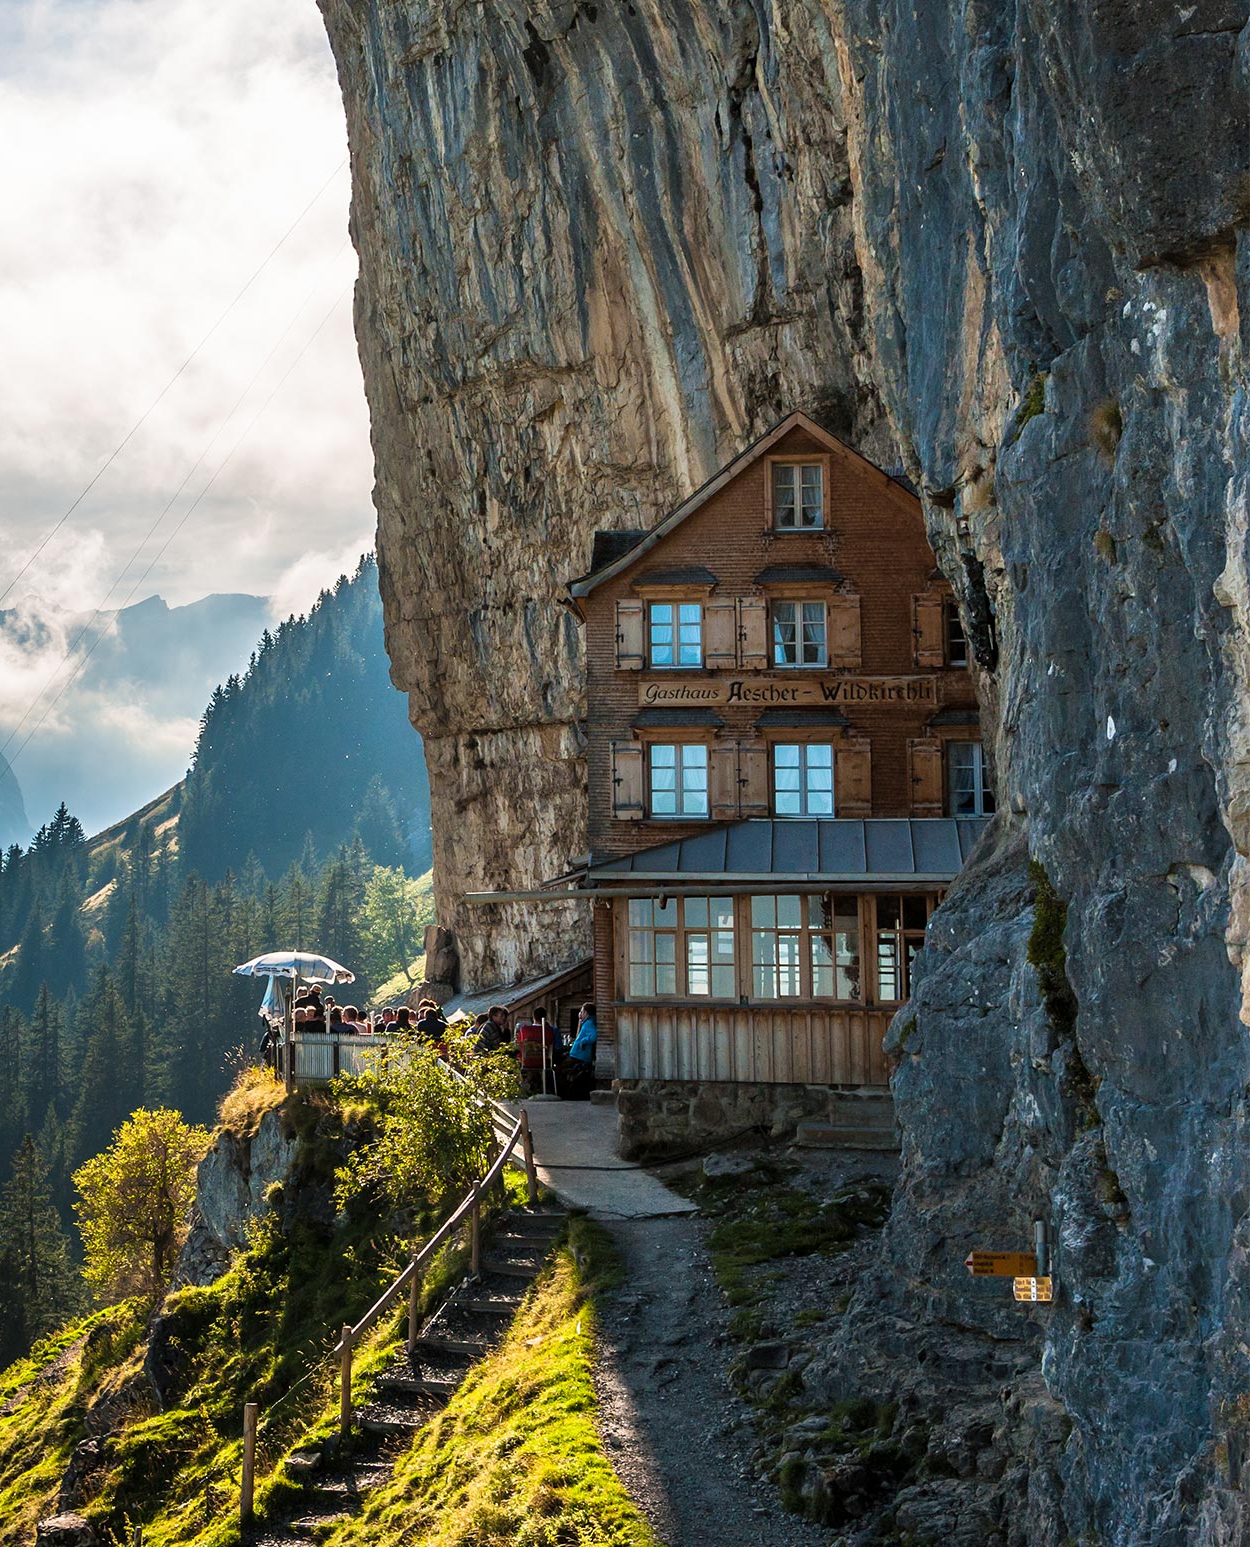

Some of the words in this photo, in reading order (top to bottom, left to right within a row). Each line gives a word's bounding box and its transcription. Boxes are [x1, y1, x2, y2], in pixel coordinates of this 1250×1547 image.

[645, 684, 719, 705] Gasthaus
[727, 682, 798, 702] Aescher
[820, 682, 931, 701] Wildkirchli
